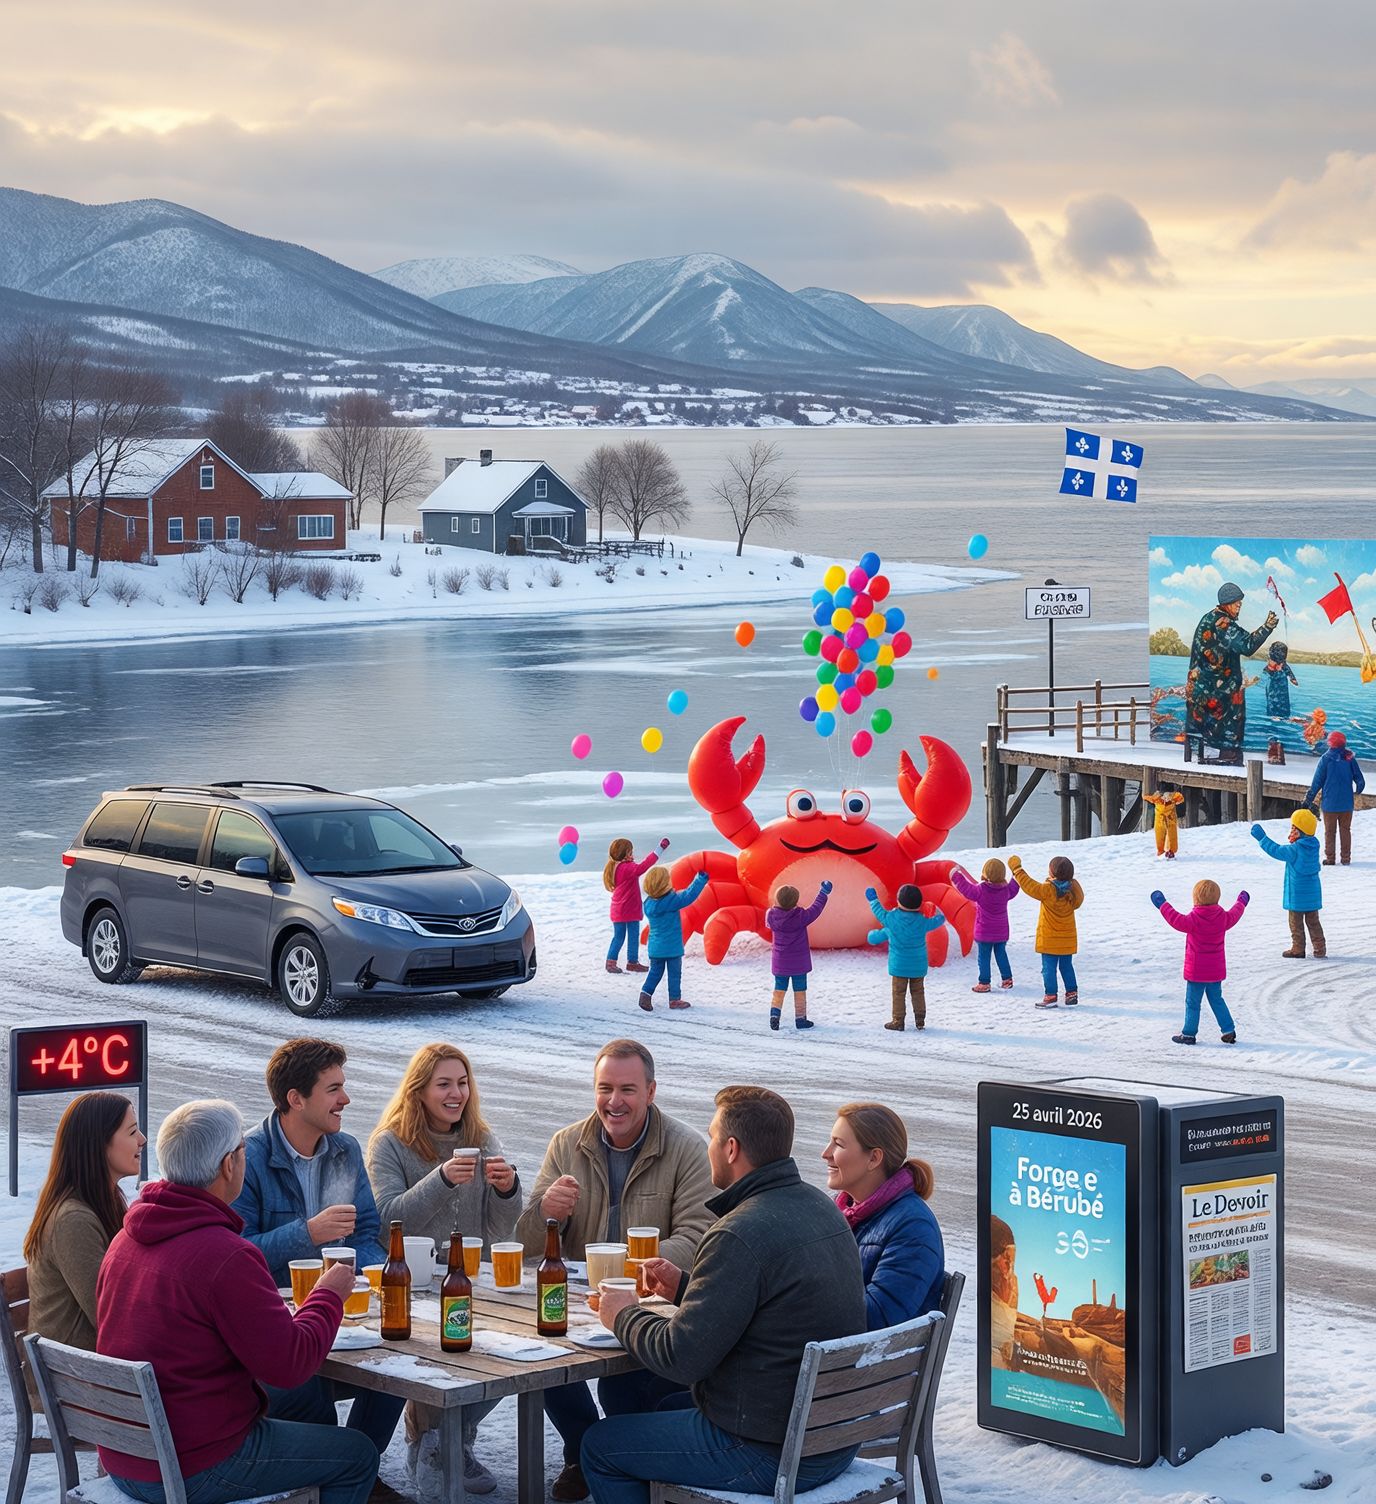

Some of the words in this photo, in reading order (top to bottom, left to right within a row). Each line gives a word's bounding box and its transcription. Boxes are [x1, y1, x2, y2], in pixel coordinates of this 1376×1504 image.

[31, 1034, 129, 1079] +4°C
[1012, 1102, 1030, 1120] 25
[1033, 1106, 1063, 1125] avril
[1067, 1109, 1103, 1129] 2026
[1009, 1181, 1022, 1206] à
[1027, 1185, 1104, 1219] Bérubé
[1192, 1198, 1212, 1218] Le
[1214, 1188, 1269, 1215] Devoir
